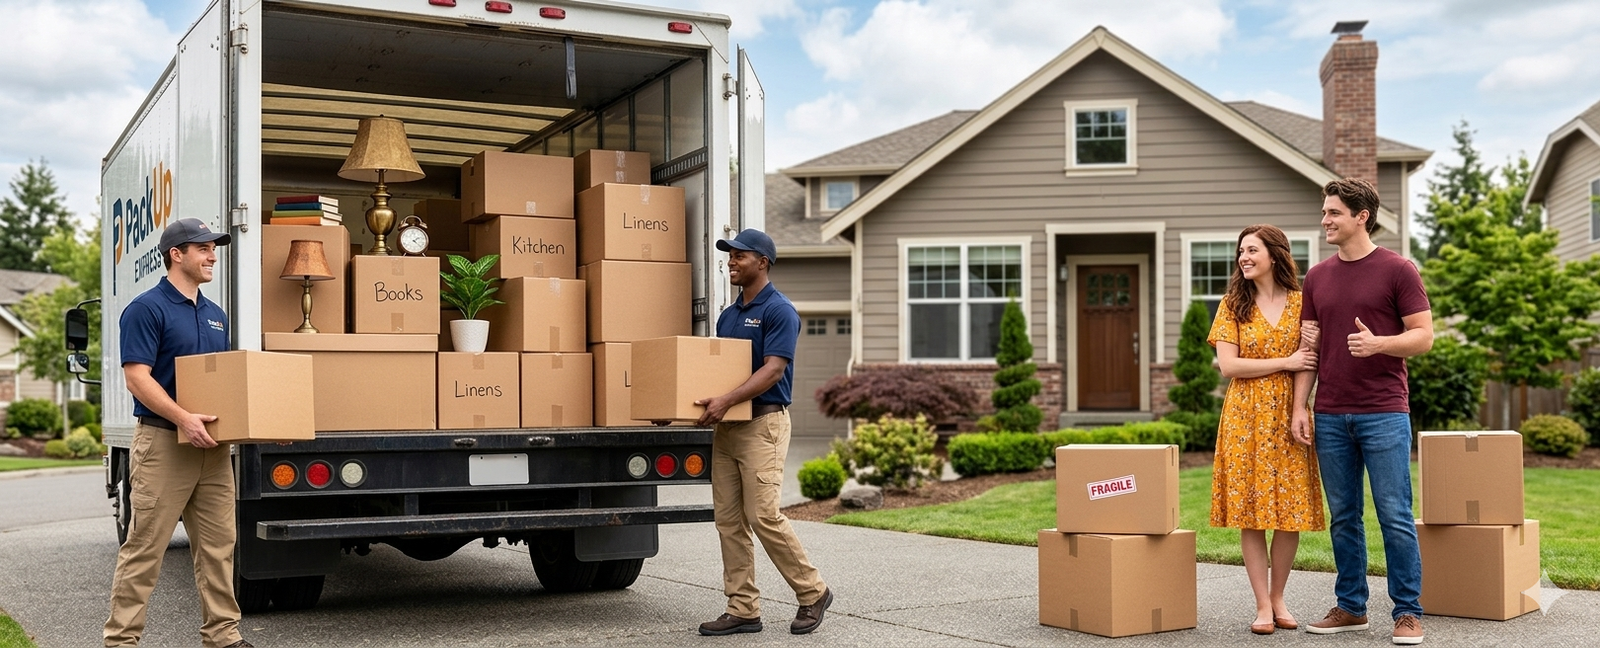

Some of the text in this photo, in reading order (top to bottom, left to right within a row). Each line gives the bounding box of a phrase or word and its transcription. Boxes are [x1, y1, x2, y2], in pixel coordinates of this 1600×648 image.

[126, 161, 172, 254] PackUp
[623, 212, 669, 232] Linens
[512, 235, 565, 255] Kitchen
[374, 281, 424, 302] Books
[454, 380, 503, 398] Linens
[1091, 479, 1133, 496] FRAGILE
